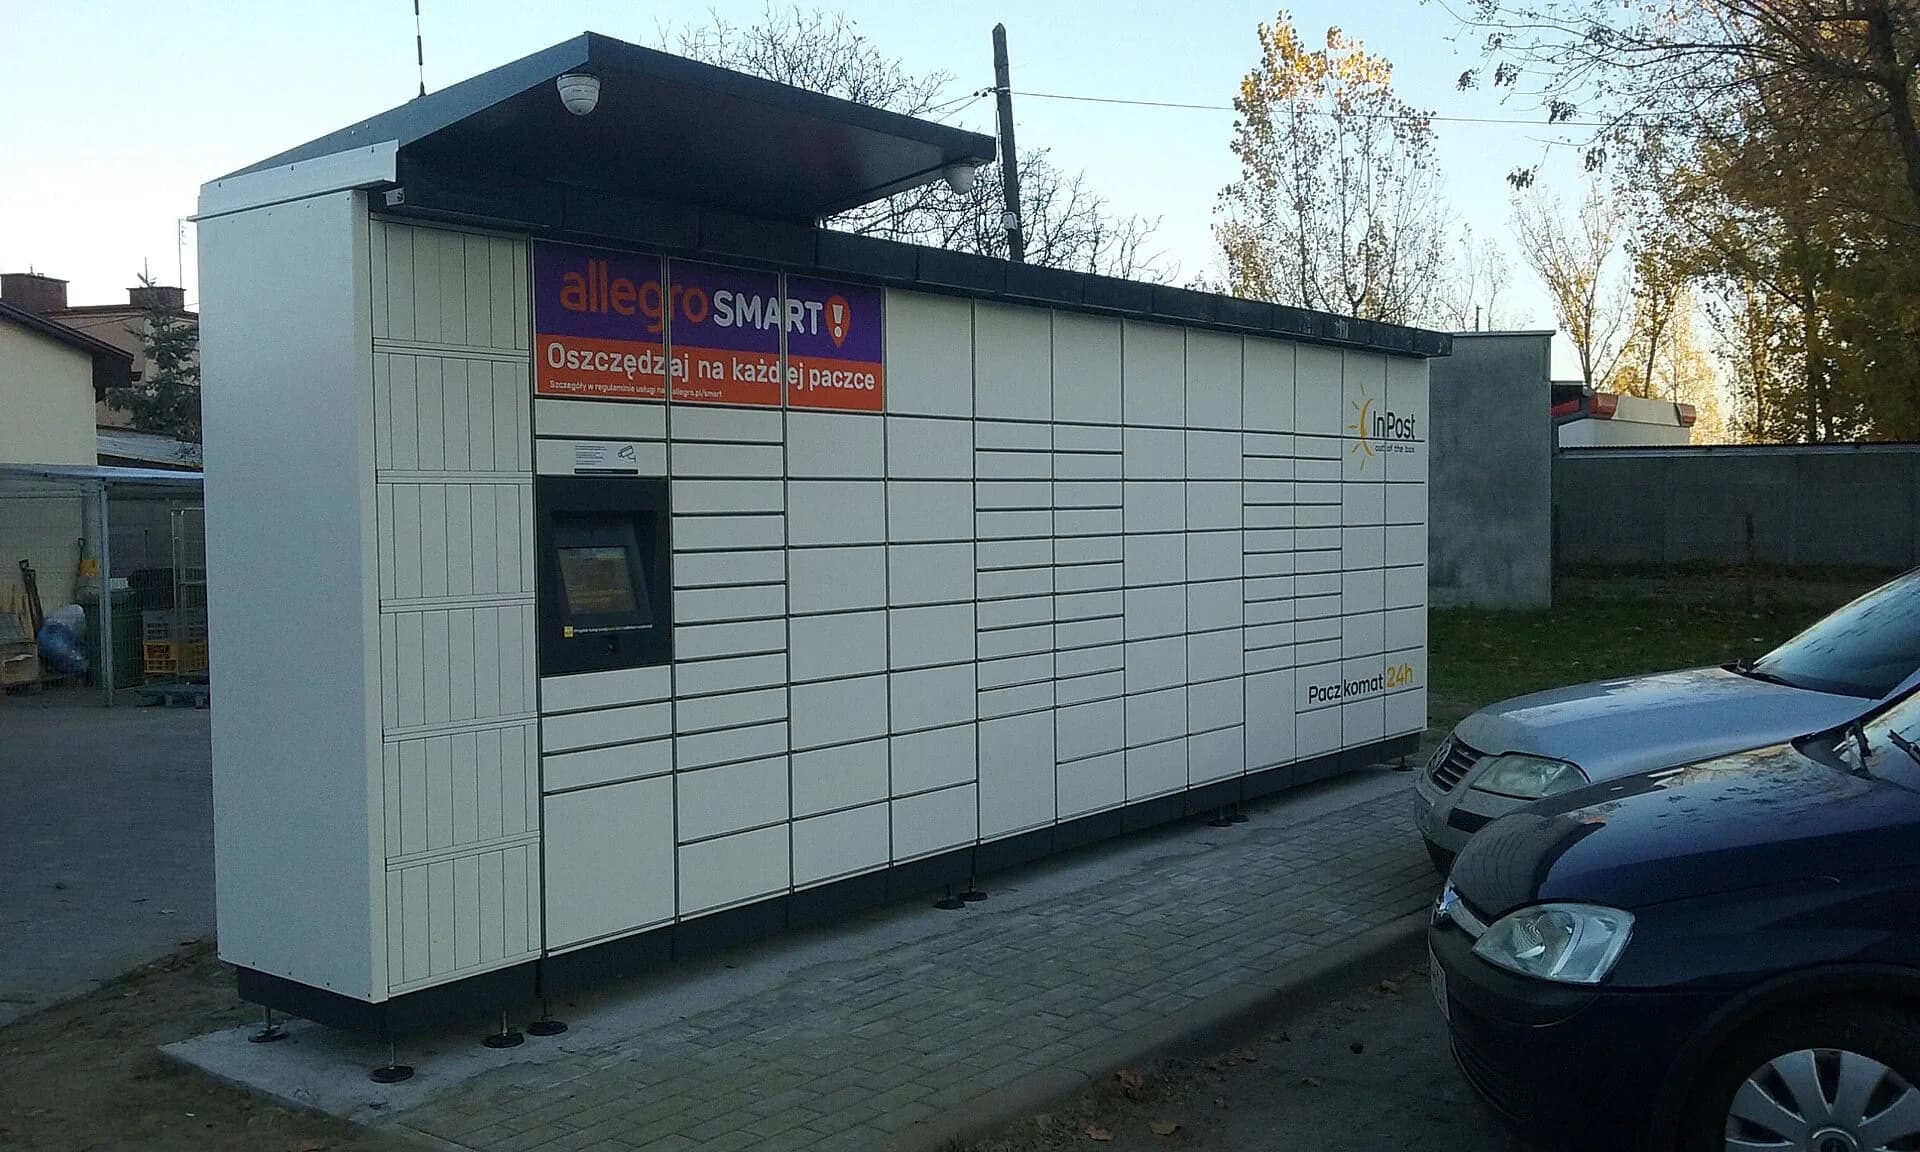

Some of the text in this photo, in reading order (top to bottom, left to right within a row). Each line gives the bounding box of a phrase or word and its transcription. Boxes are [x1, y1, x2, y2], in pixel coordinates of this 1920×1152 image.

[560, 258, 709, 334] allegro
[547, 342, 875, 392] Oszczędzaj na każdej paczce
[1373, 410, 1415, 440] InPost
[1394, 444, 1404, 453] the
[1404, 445, 1415, 453] box
[1308, 663, 1413, 704] Paczkomat 24h
